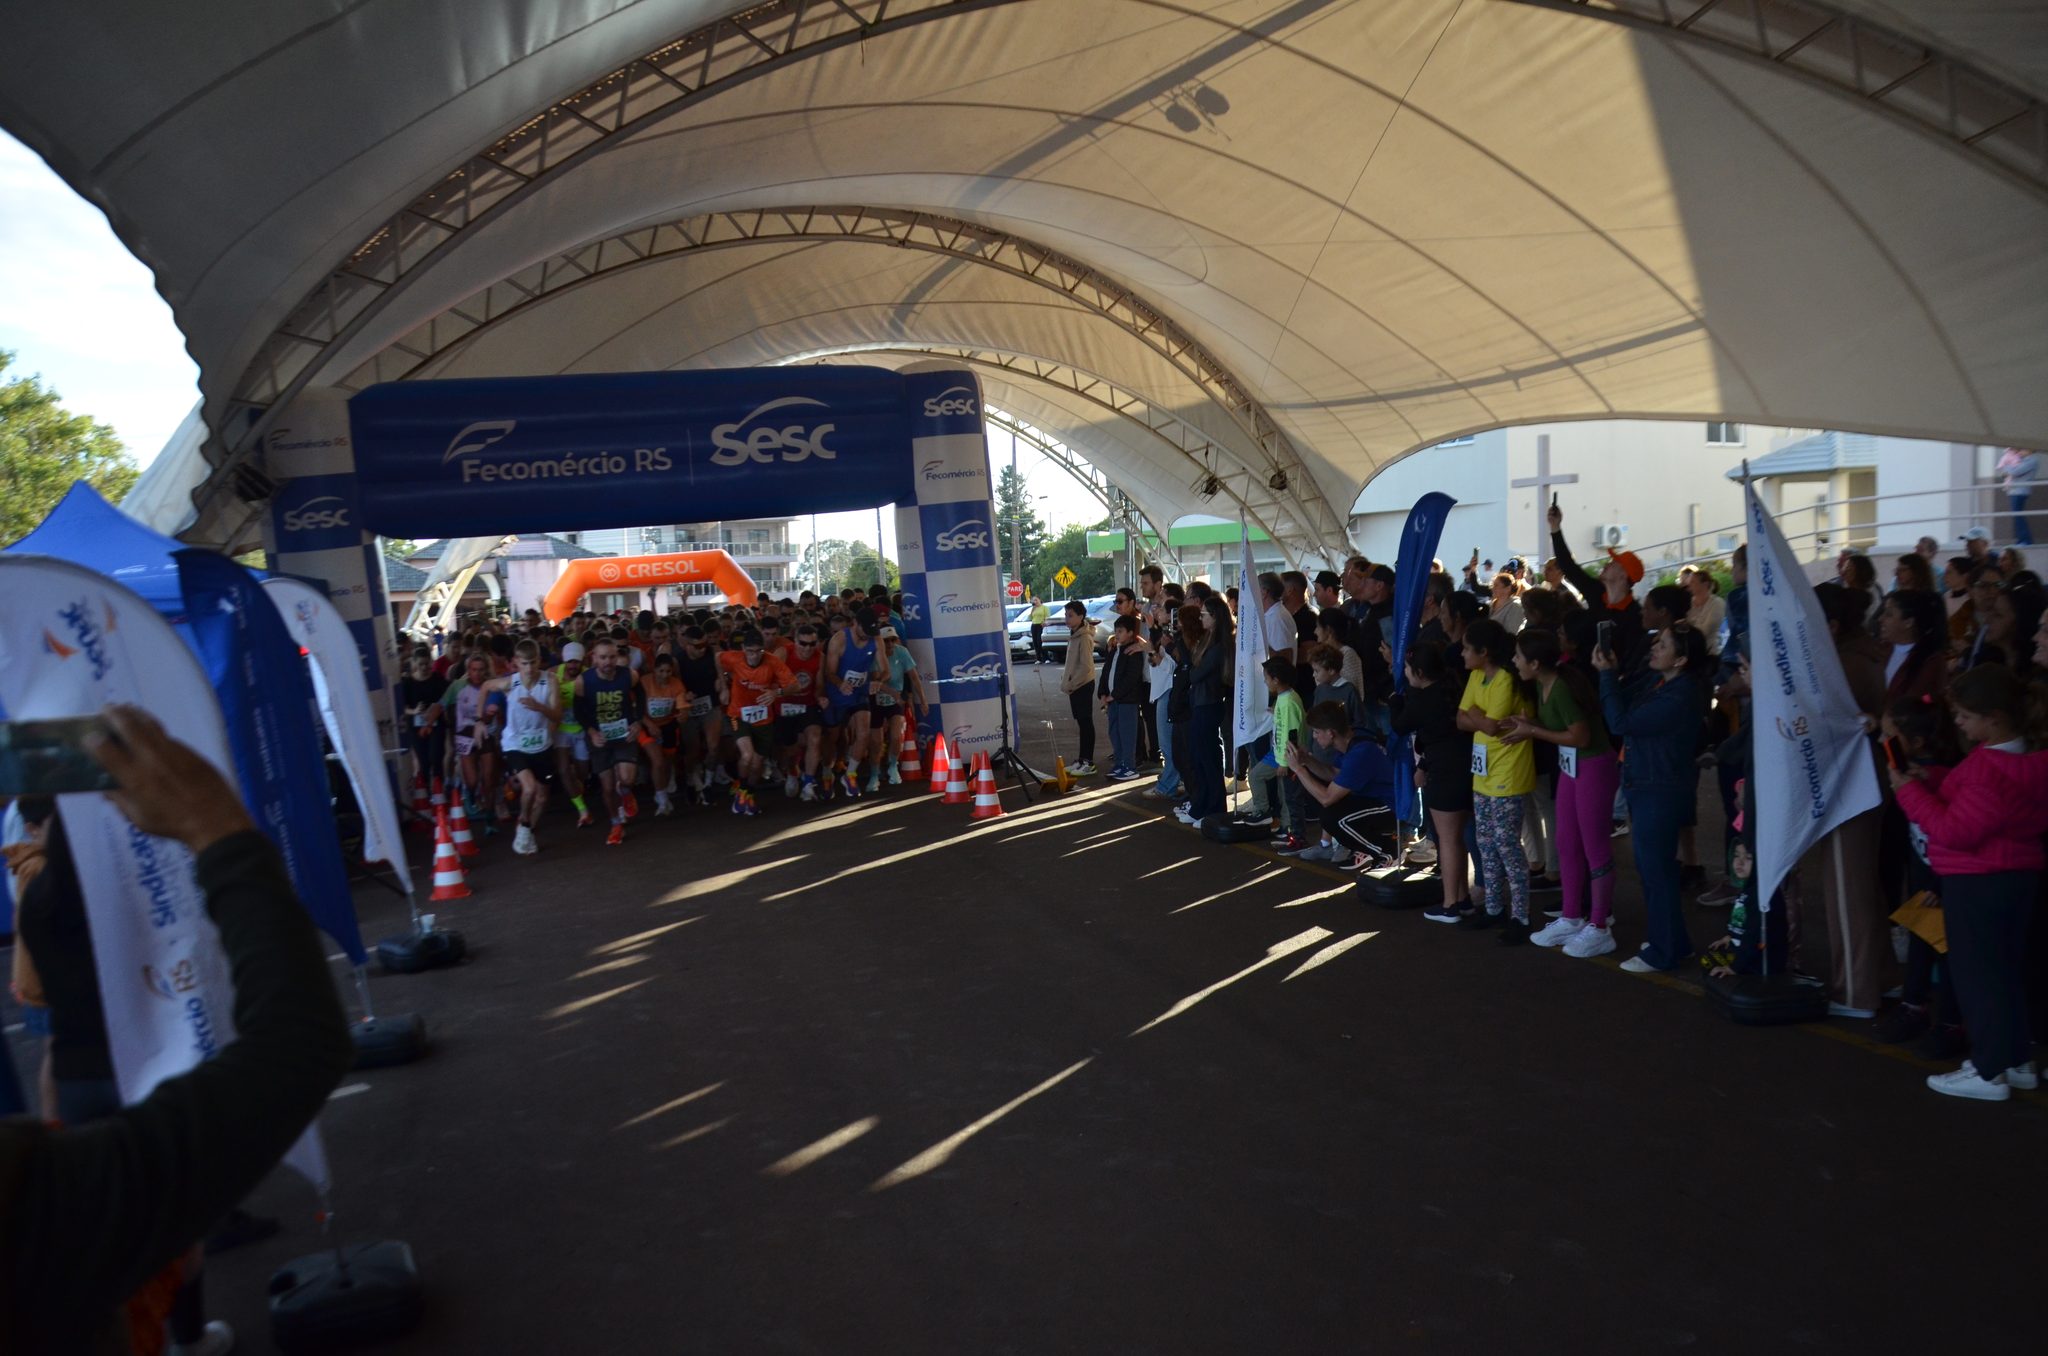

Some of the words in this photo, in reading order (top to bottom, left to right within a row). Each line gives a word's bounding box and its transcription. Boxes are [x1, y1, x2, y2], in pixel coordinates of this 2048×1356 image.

[923, 398, 976, 417] Sesc
[271, 438, 333, 451] Fecomércio
[334, 437, 348, 447] RS
[709, 423, 837, 466] Sesc
[461, 451, 626, 483] Fecomércio
[634, 447, 673, 472] RS
[925, 469, 976, 482] Fecomércio
[283, 507, 351, 531] Sesc
[935, 530, 989, 551] Sesc
[626, 560, 700, 579] CRESOL
[940, 600, 991, 613] Fecomércio
[951, 662, 1003, 684] Sesc
[596, 690, 624, 704] INS
[745, 709, 765, 720] 717
[955, 726, 1005, 744] Fecomércio
[1794, 715, 1809, 736] RS
[522, 735, 544, 748] 244
[1798, 739, 1825, 820] Fecomércio
[172, 959, 195, 993] RS
